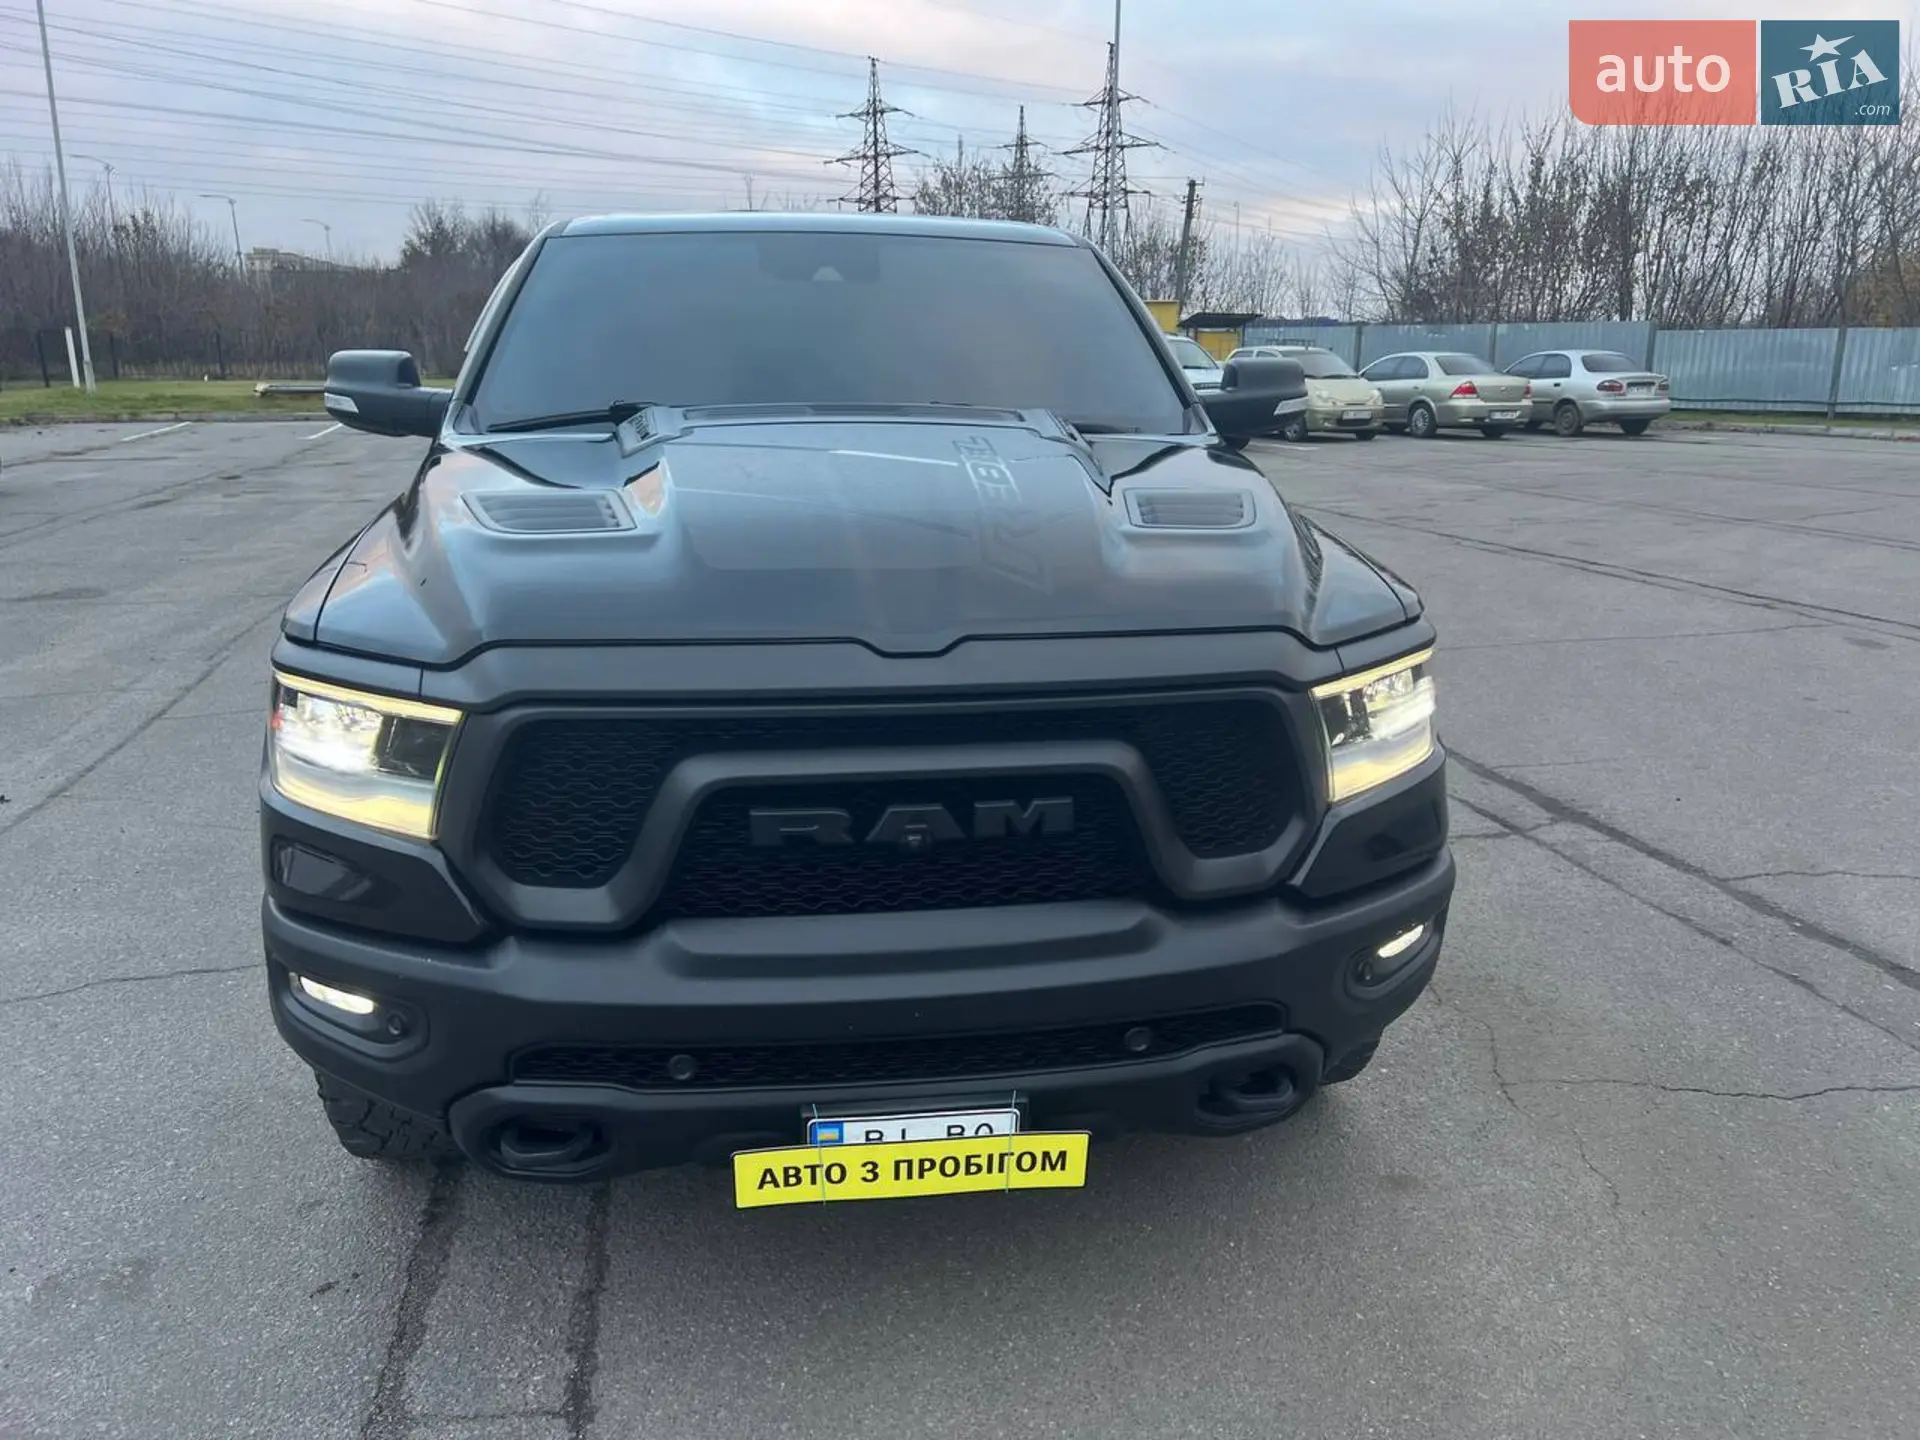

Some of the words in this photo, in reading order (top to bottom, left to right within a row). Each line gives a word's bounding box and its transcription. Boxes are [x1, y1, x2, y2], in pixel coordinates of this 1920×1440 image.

[750, 796, 1074, 846] RAM
[757, 1162, 848, 1190] АВТО
[893, 1150, 1068, 1181] ПРОБІГОМ
